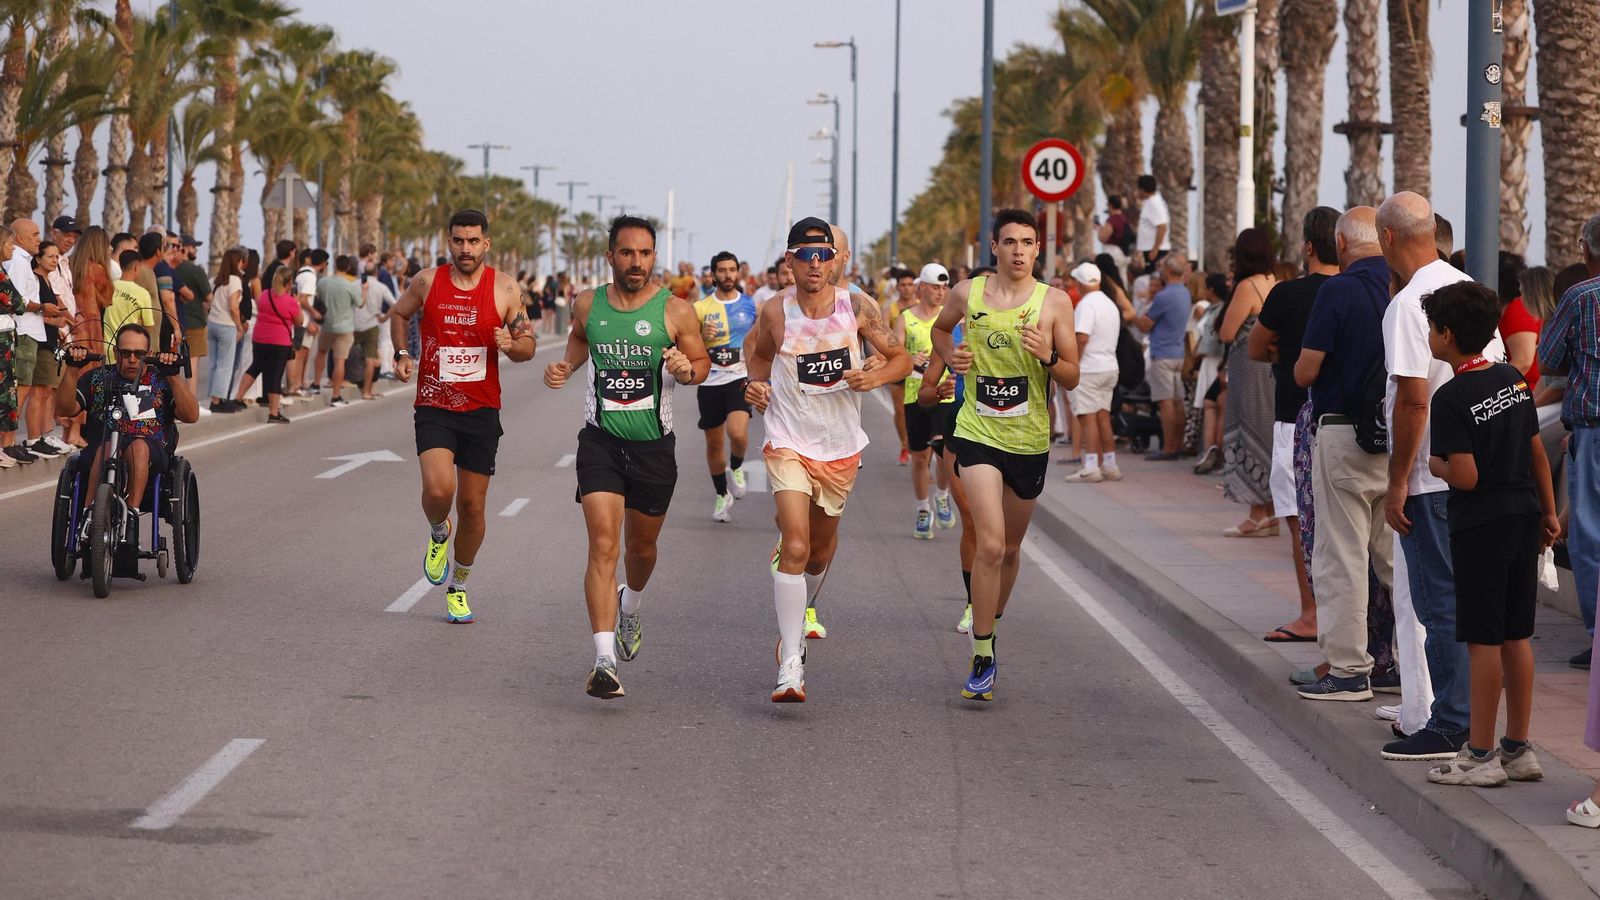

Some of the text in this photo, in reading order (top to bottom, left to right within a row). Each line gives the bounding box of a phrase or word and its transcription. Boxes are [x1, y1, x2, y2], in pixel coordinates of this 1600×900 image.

[1035, 158, 1068, 180] 40
[595, 338, 652, 359] mijas
[716, 352, 732, 360] 291
[447, 354, 480, 364] 3597
[806, 358, 843, 374] 2716
[606, 378, 645, 389] 2695
[984, 384, 1019, 396] 1348
[1470, 384, 1520, 416] POLICIA
[1474, 391, 1530, 425] NACONAL
